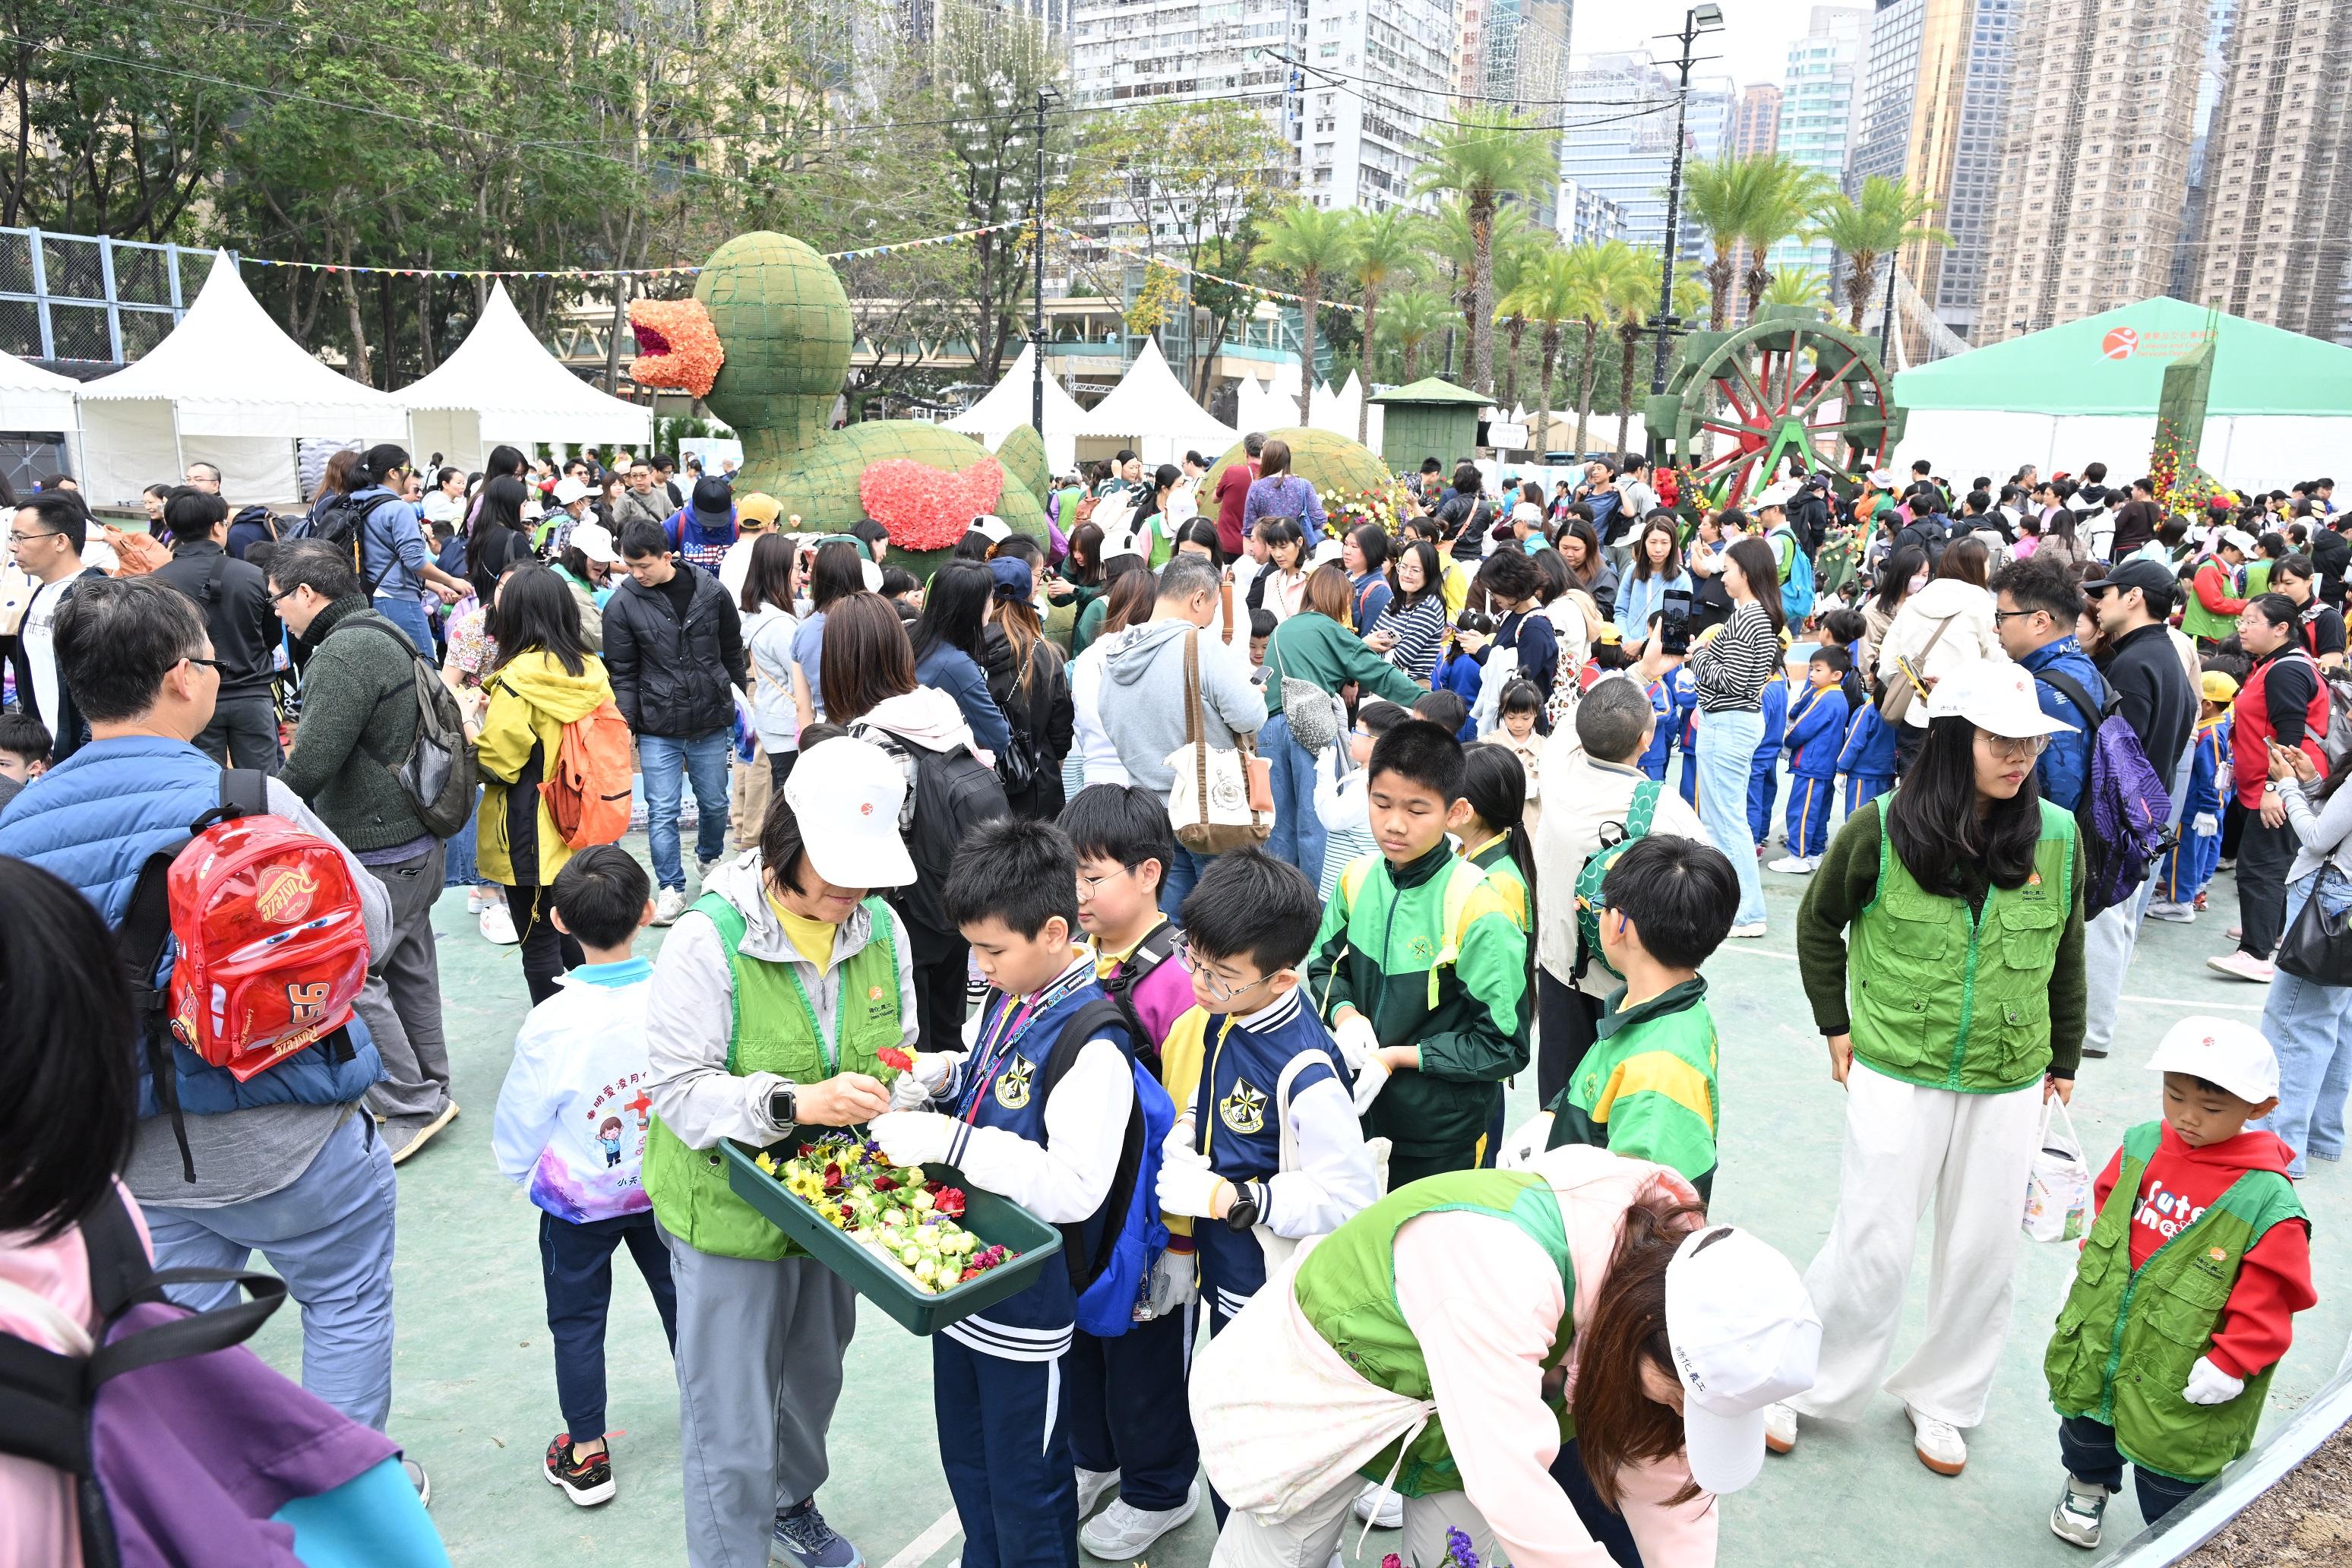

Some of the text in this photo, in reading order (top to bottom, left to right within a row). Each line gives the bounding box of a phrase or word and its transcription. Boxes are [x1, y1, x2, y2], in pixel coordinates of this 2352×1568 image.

[288, 982, 330, 1024] 95
[1234, 1112, 1247, 1122] LIFE
[617, 1175, 642, 1187] 小天
